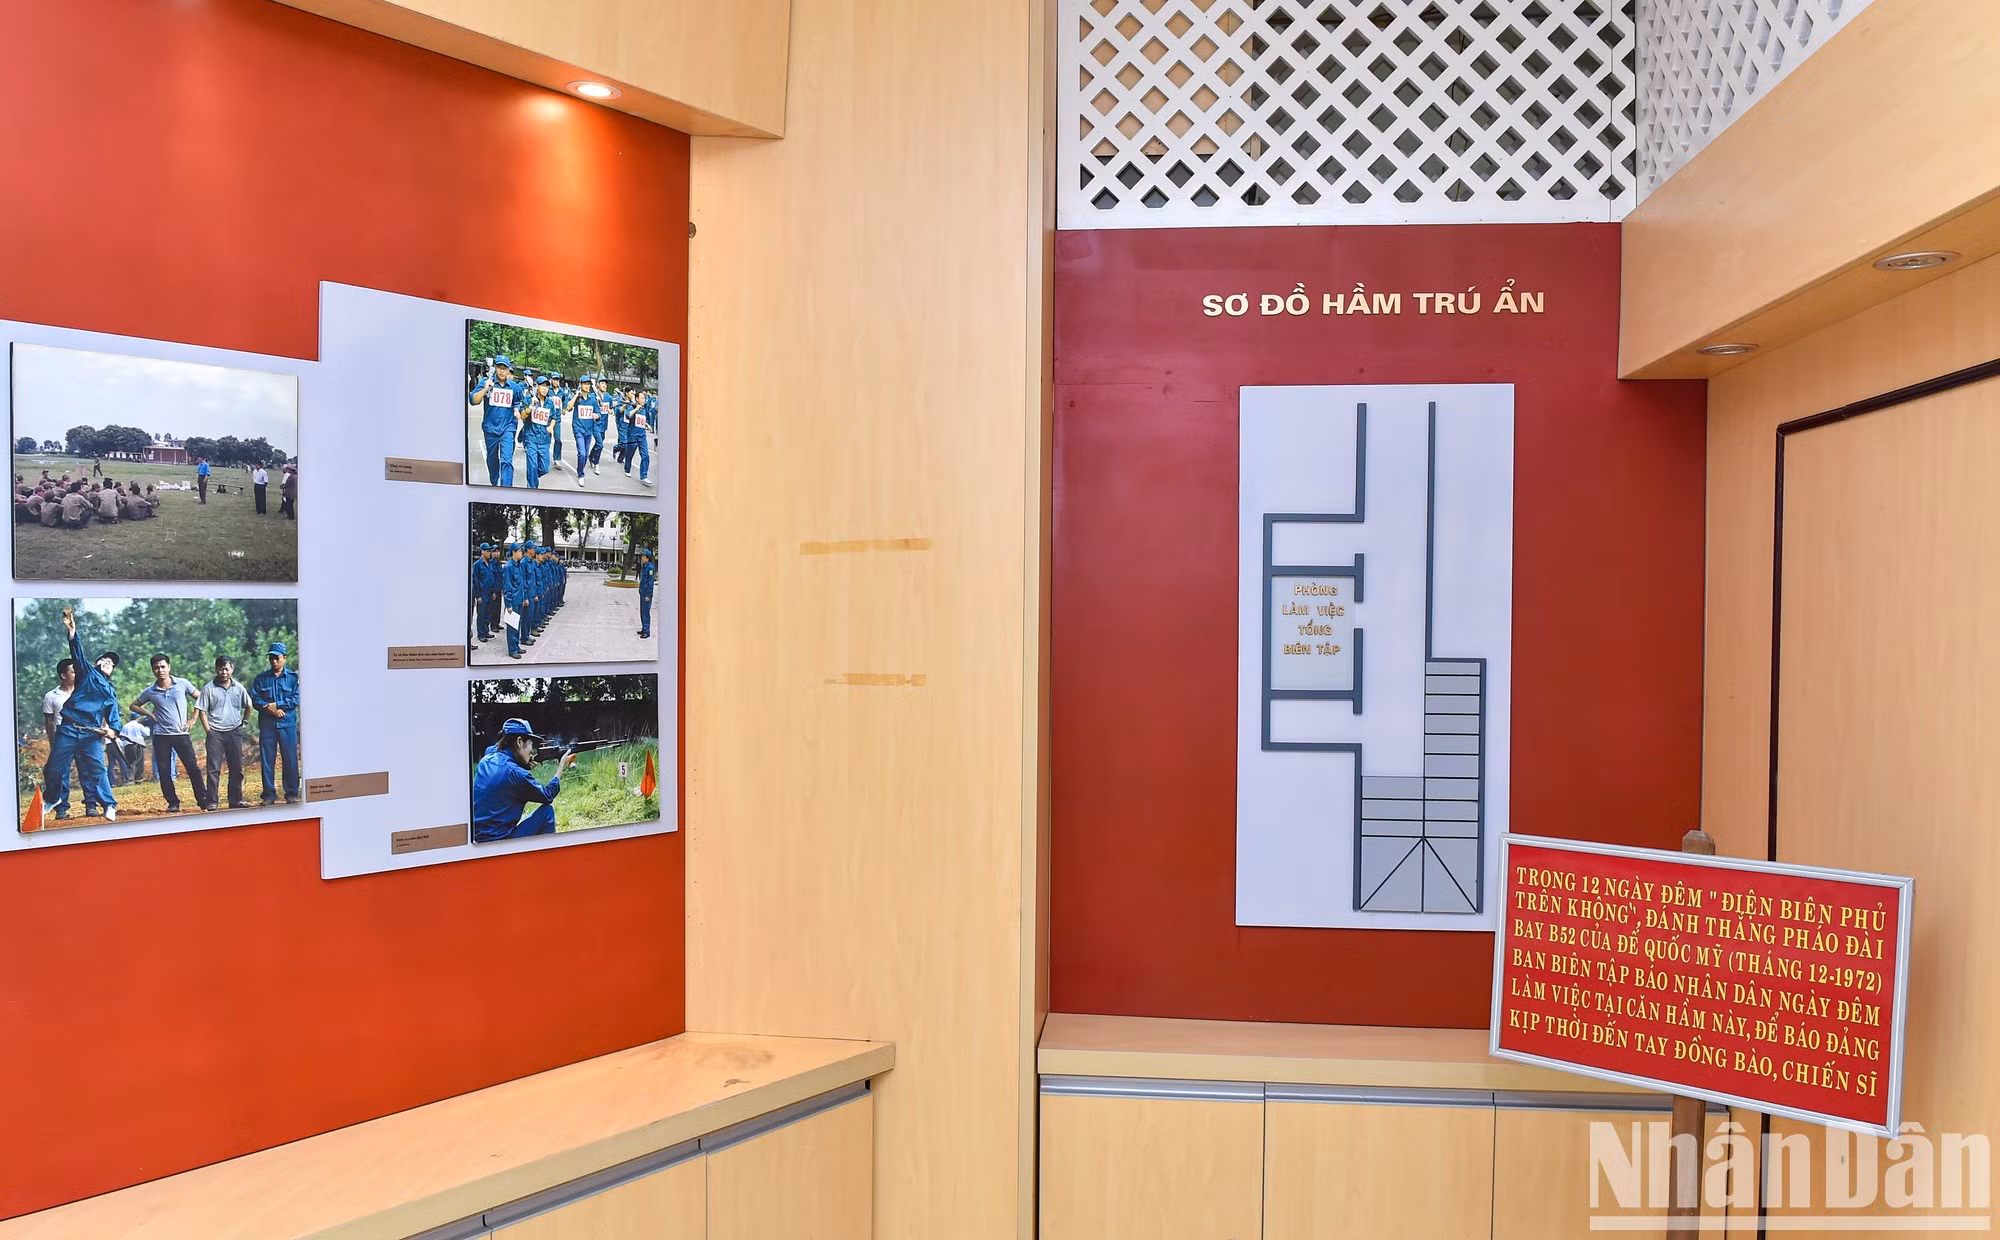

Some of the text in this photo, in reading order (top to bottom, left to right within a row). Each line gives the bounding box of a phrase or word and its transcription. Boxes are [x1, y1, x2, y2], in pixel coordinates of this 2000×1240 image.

[1202, 278, 1545, 317] SƠ ĐỒ HẦM TRÚ ẨN
[1282, 601, 1345, 619] LÀM VIỆC
[1294, 582, 1338, 596] PHÒNG
[1284, 642, 1341, 656] BIÊN TẬP
[621, 765, 626, 775] 5
[1515, 889, 1562, 914] TRÊN
[1645, 905, 1700, 934] ĐÁNH
[1705, 911, 1777, 945] THẮNG
[1783, 925, 1839, 954] PHÁO
[1845, 931, 1884, 960] ĐÀI
[1516, 866, 1577, 891] TRONG
[1581, 876, 1600, 895] 12
[1604, 875, 1655, 902] NGÀY
[1660, 880, 1703, 908] ĐÊM
[1779, 896, 1833, 925] BIÊN
[1840, 901, 1886, 932] PHỦ
[1512, 948, 1881, 1027] BAN BIÊN TẬP BÁO NHÂN DÂN NGÀY ĐÊM
[1513, 919, 1883, 996] BAY B52 CỦA ĐẾ QUỐC MỸ (THÁNG 12-1972)
[1511, 973, 1881, 1062] LÀM VIỆC TẠI CĂN HẦM NÀY, ĐỂ BÁO ĐẢNG
[1509, 1008, 1878, 1098] KỊP THỜI ĐẾN TAY ĐỒNG BÀO, CHIẾN SĨ
